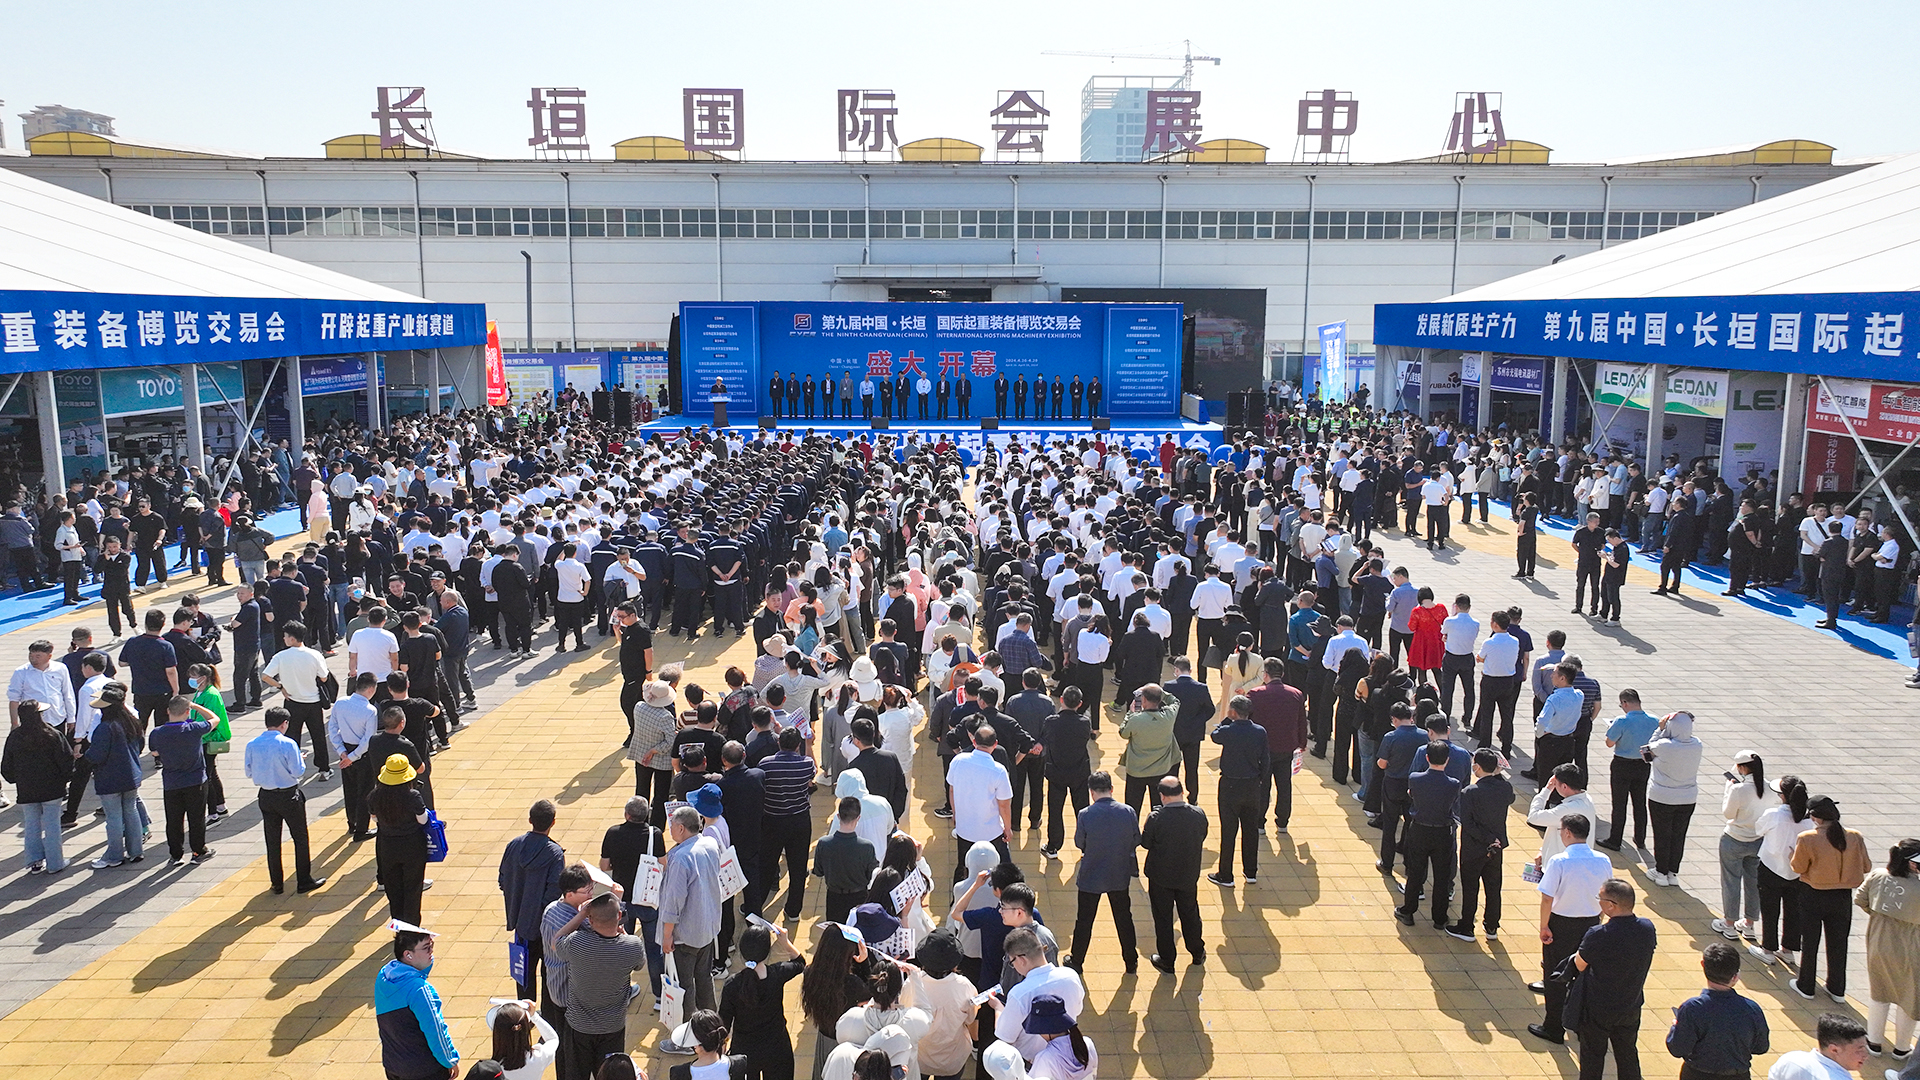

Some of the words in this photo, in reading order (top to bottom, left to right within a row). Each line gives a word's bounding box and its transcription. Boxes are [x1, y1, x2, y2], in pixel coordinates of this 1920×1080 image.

[371, 87, 1508, 154] 长垣国际会展中心
[0, 309, 285, 353] 重装备博览交易会
[321, 312, 454, 340] 开辟起重产业新赛道
[822, 315, 926, 331] 第九届中国·长垣
[937, 315, 1082, 331] 国际起重装备博览交易会
[1416, 312, 1517, 339] 发展新质生产力
[58, 375, 92, 386] TOYO
[137, 379, 176, 398] TOYO
[1604, 370, 1647, 389] LEDAN
[1666, 378, 1718, 397] LEDAN
[1732, 389, 1785, 411] LE
